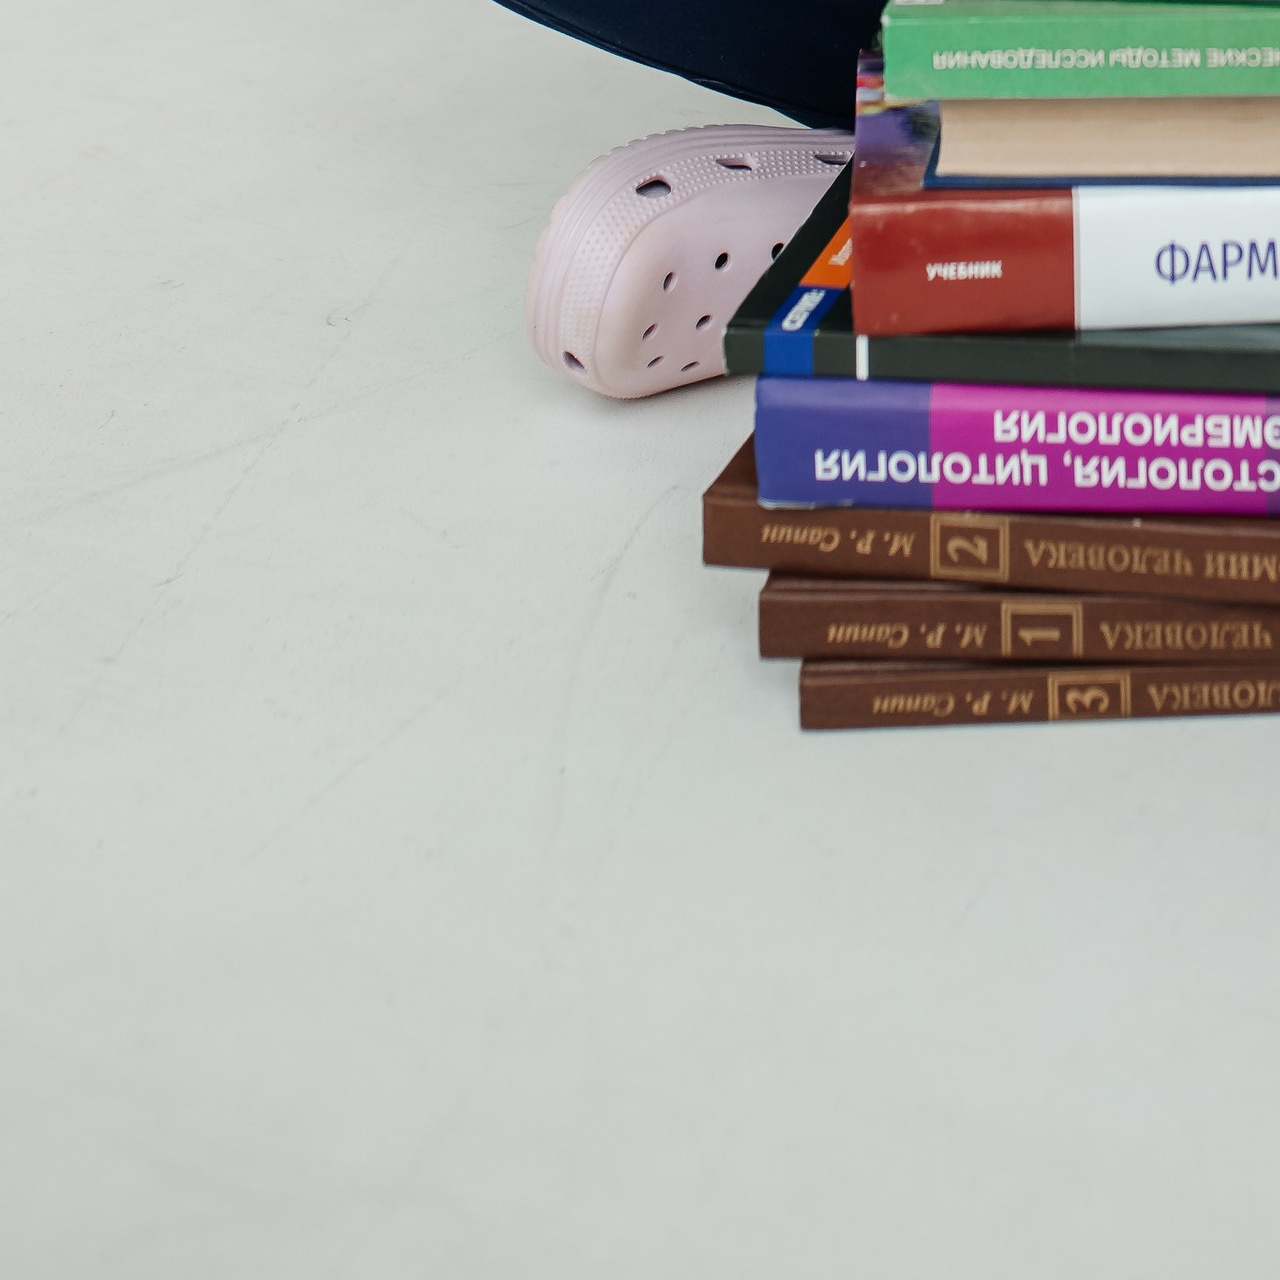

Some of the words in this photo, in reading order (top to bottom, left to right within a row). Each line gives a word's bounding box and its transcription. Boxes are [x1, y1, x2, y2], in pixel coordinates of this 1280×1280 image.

[932, 47, 1105, 71] ИССЛЕДОВАНИЯ
[1109, 46, 1201, 70] МЕТОДЫ
[926, 260, 1003, 281] УЧЕБНИК
[813, 448, 1050, 489] ЦИТОЛОГИЯ
[761, 523, 842, 554] Сапин
[849, 529, 876, 556] Р.
[883, 531, 916, 558] М.
[946, 538, 988, 562] 2
[1023, 540, 1191, 577] ЧЕЛОВЕКА
[826, 623, 911, 650] Сапин
[919, 622, 946, 650] Р.
[955, 623, 988, 650] М.
[1018, 627, 1062, 646] 1
[1098, 621, 1272, 652] ЧЕЛОВЕКА
[872, 691, 957, 717] Сапин
[964, 691, 992, 716] Р.
[1001, 691, 1034, 715] М.
[1066, 684, 1110, 710] 3
